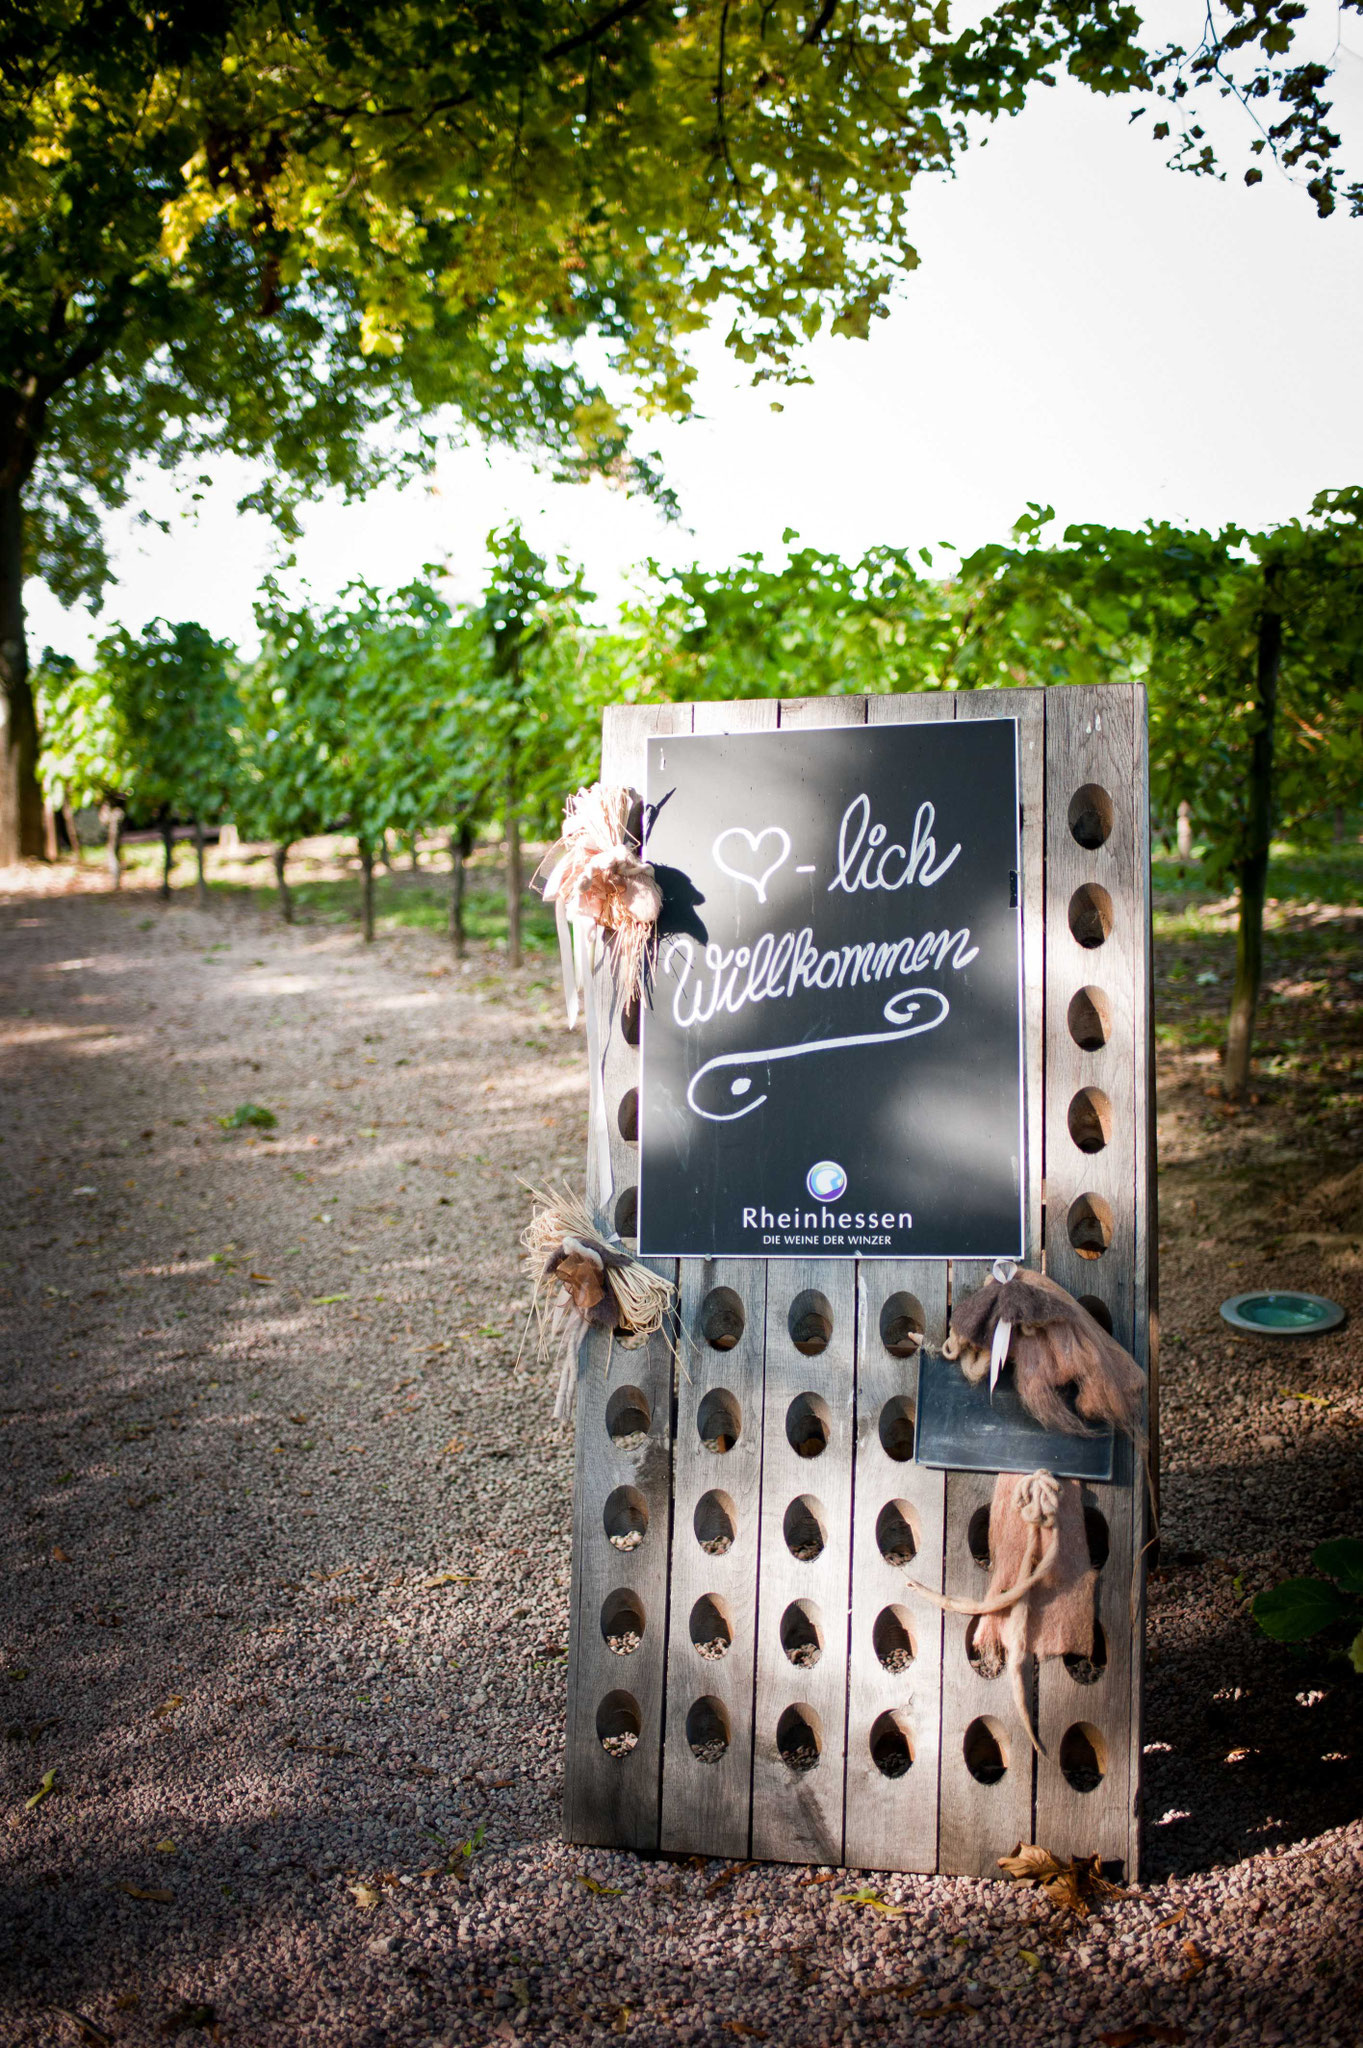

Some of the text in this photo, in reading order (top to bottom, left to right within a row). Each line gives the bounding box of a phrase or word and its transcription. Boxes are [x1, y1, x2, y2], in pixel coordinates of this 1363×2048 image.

[664, 927, 980, 1027] Willkommen
[742, 1206, 913, 1229] Rheinhessen
[763, 1235, 892, 1245] DIE WEINE DER WINZER
